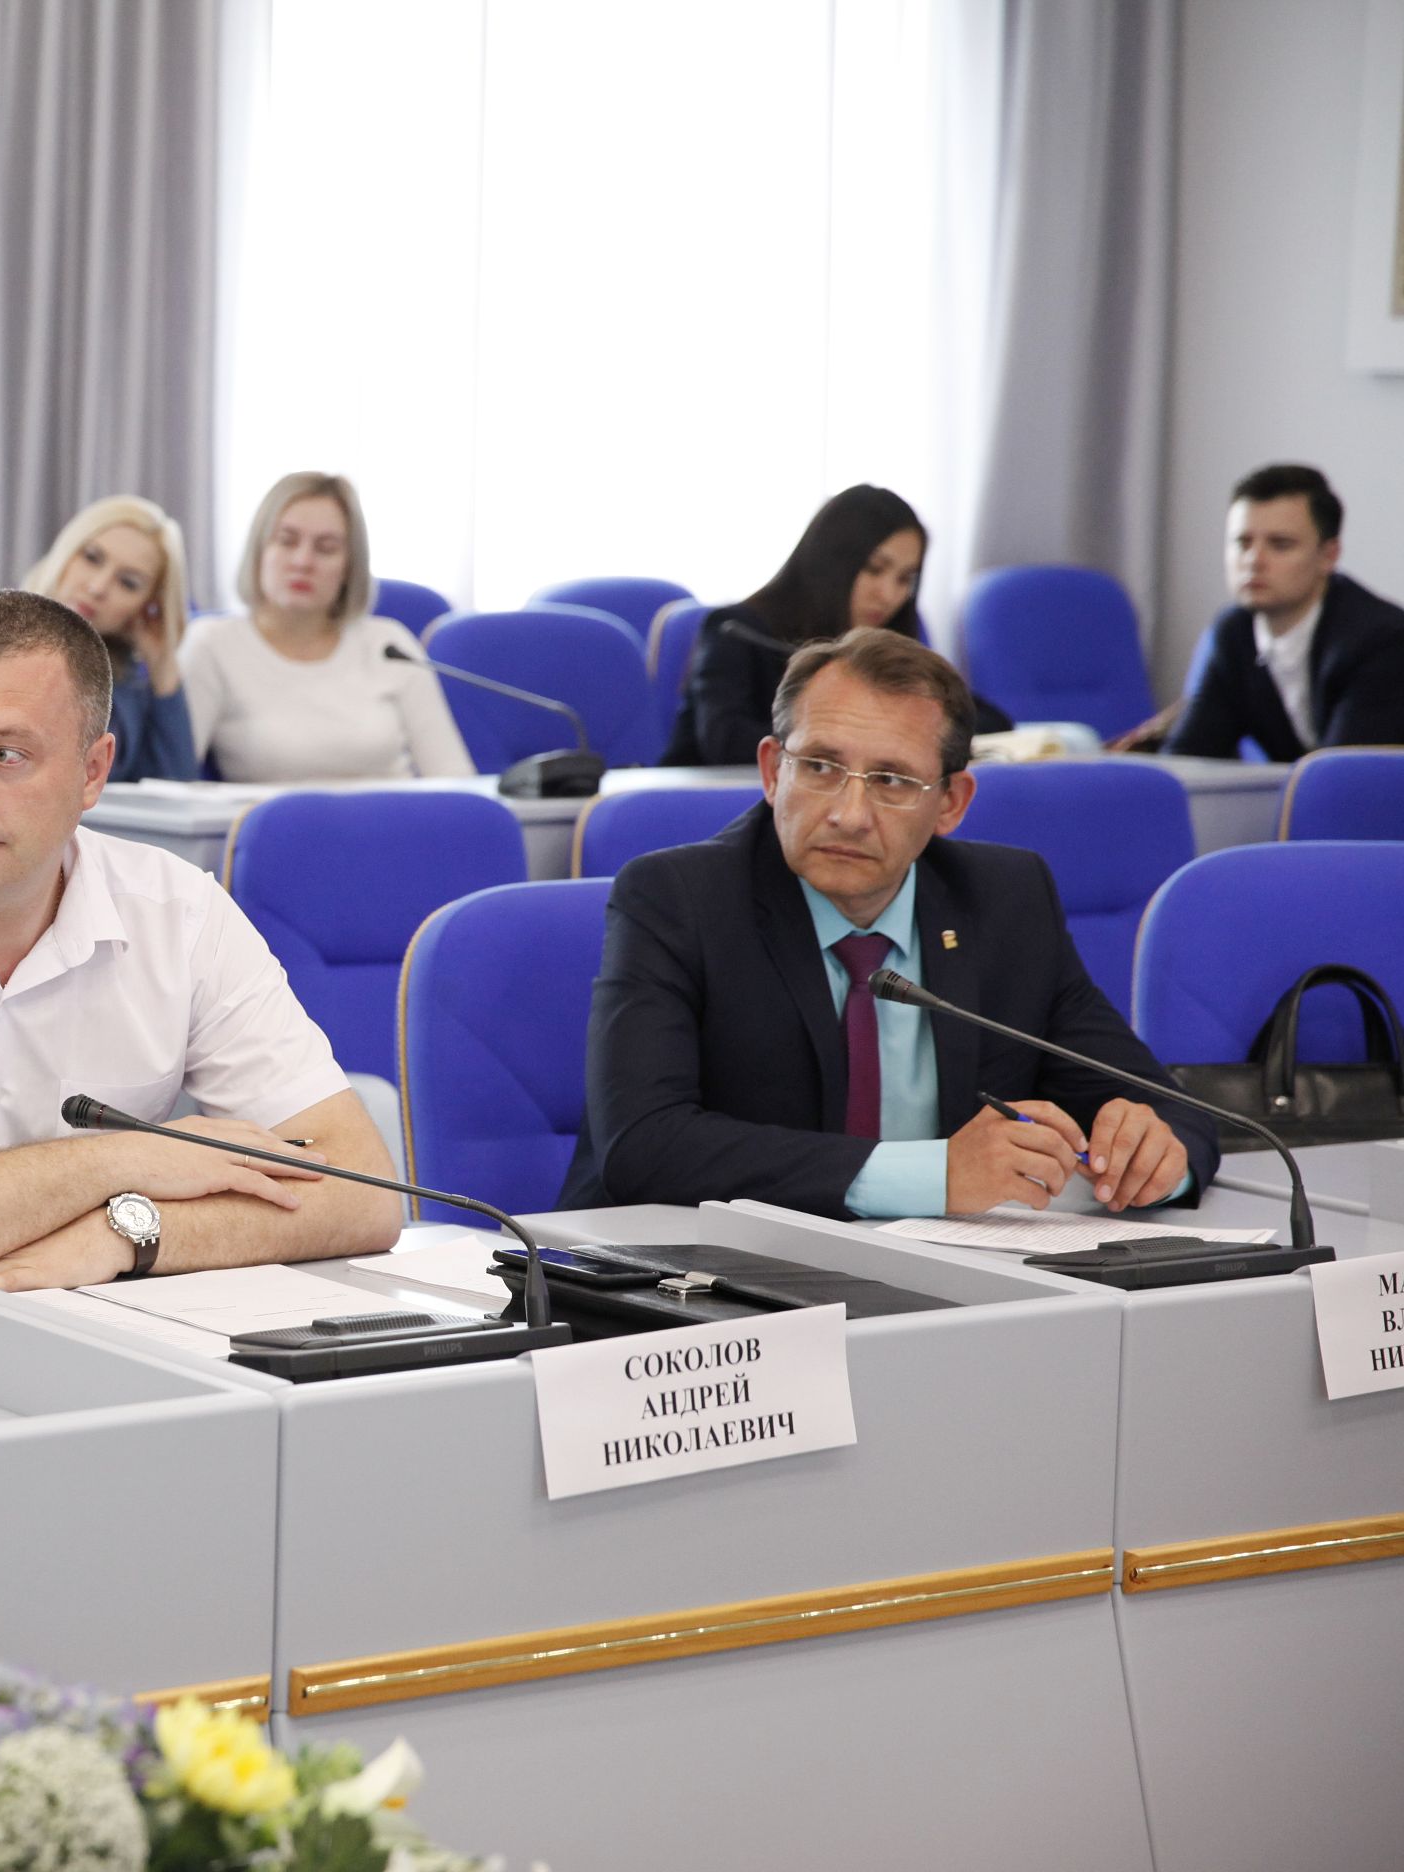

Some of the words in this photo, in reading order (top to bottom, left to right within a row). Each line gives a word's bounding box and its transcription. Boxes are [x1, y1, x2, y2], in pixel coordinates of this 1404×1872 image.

[423, 1342, 464, 1357] PHILIPS
[625, 1338, 761, 1381] СОКОЛОВ
[642, 1373, 751, 1419] АНДРЕЙ
[603, 1411, 796, 1466] НИКОЛАЕВИЧ
